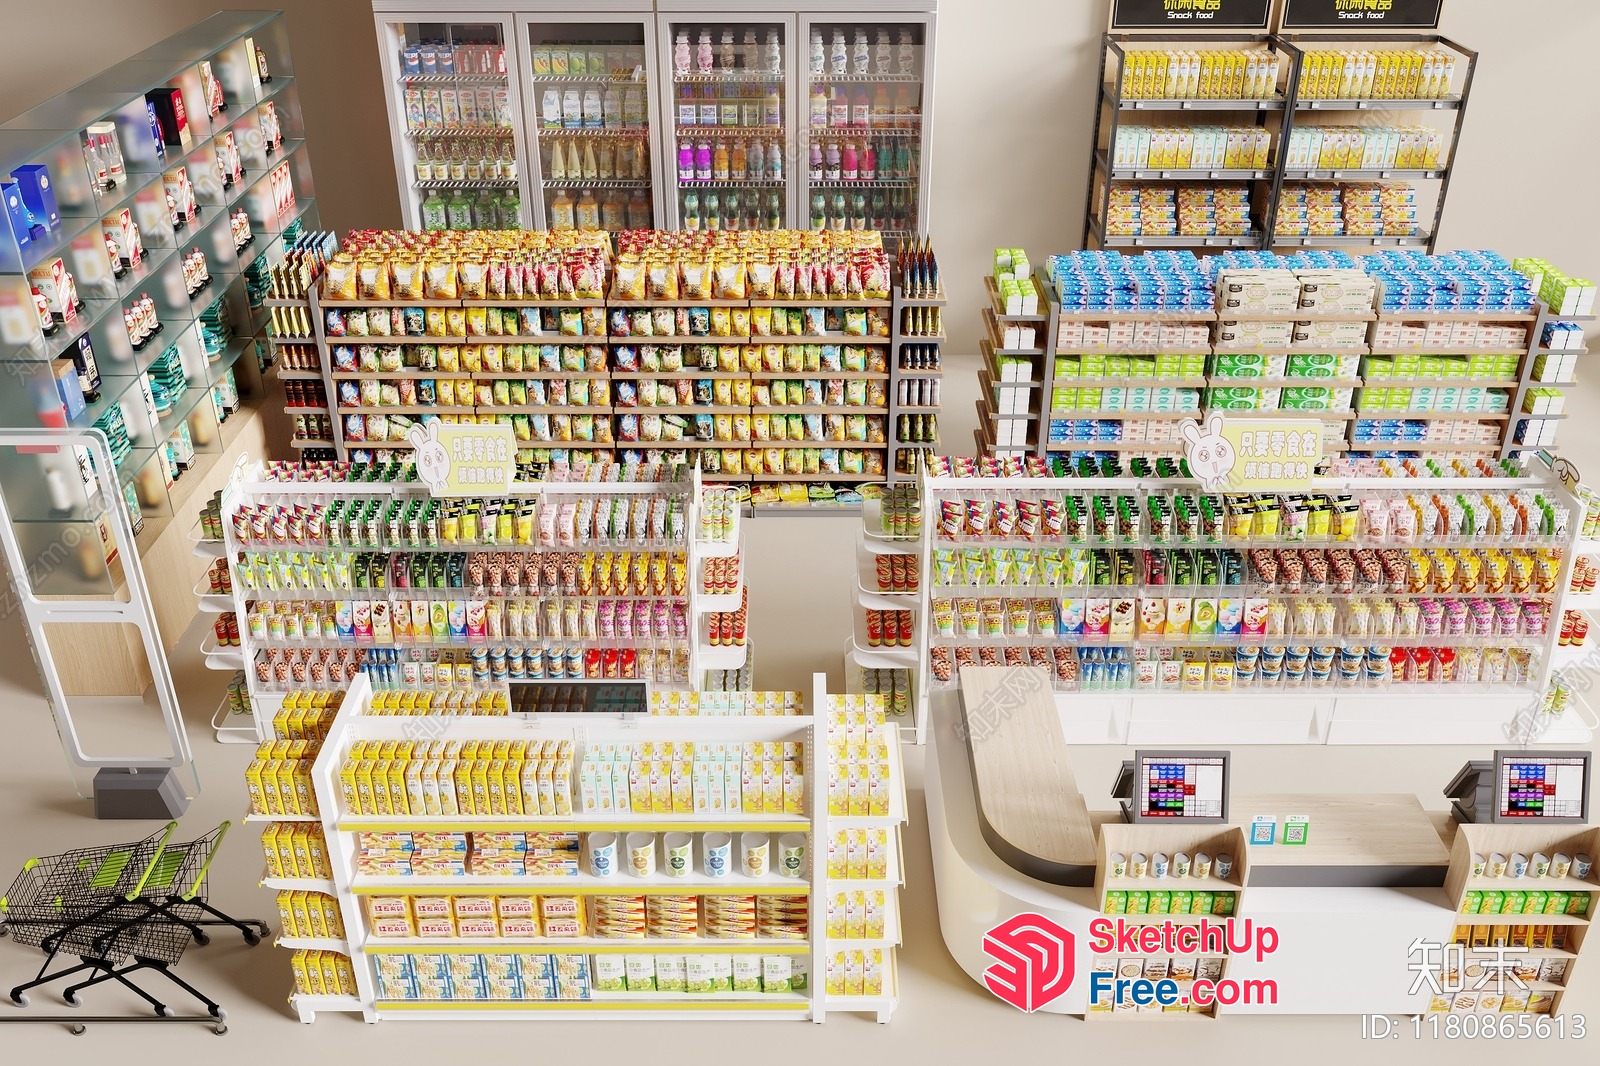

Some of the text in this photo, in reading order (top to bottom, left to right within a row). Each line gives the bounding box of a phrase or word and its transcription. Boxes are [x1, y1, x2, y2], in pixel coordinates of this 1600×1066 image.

[1167, 11, 1214, 19] Snack food
[1338, 11, 1385, 19] Snack food
[452, 436, 508, 463] 只要零食在
[1239, 430, 1318, 457] 只要零食在
[1245, 461, 1309, 479] 烦恼跑得快
